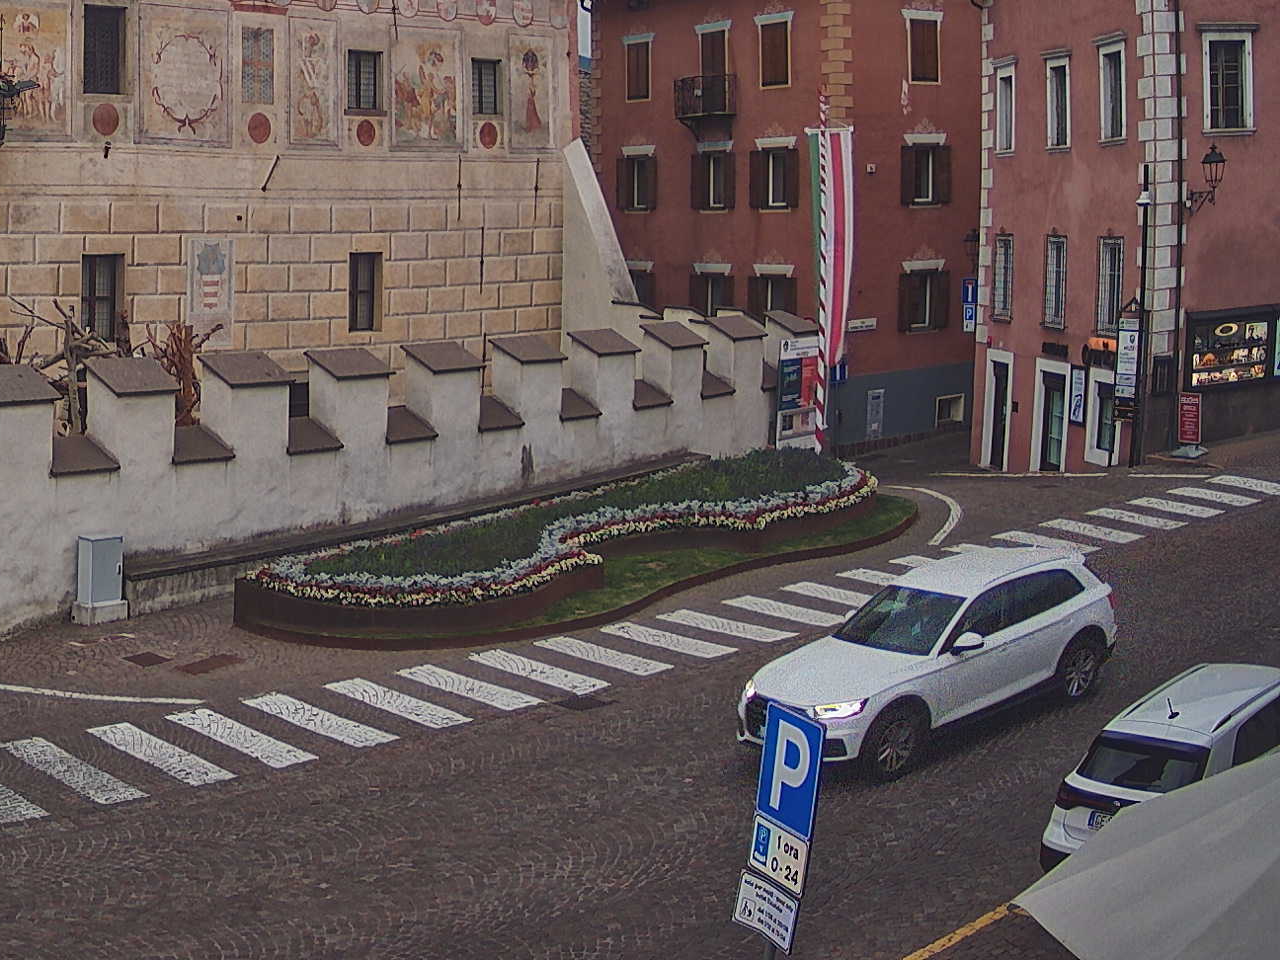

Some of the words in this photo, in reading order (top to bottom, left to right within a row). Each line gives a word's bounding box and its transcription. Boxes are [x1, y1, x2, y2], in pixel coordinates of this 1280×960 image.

[769, 718, 811, 811] P
[777, 835, 782, 851] 1
[783, 842, 799, 860] ora
